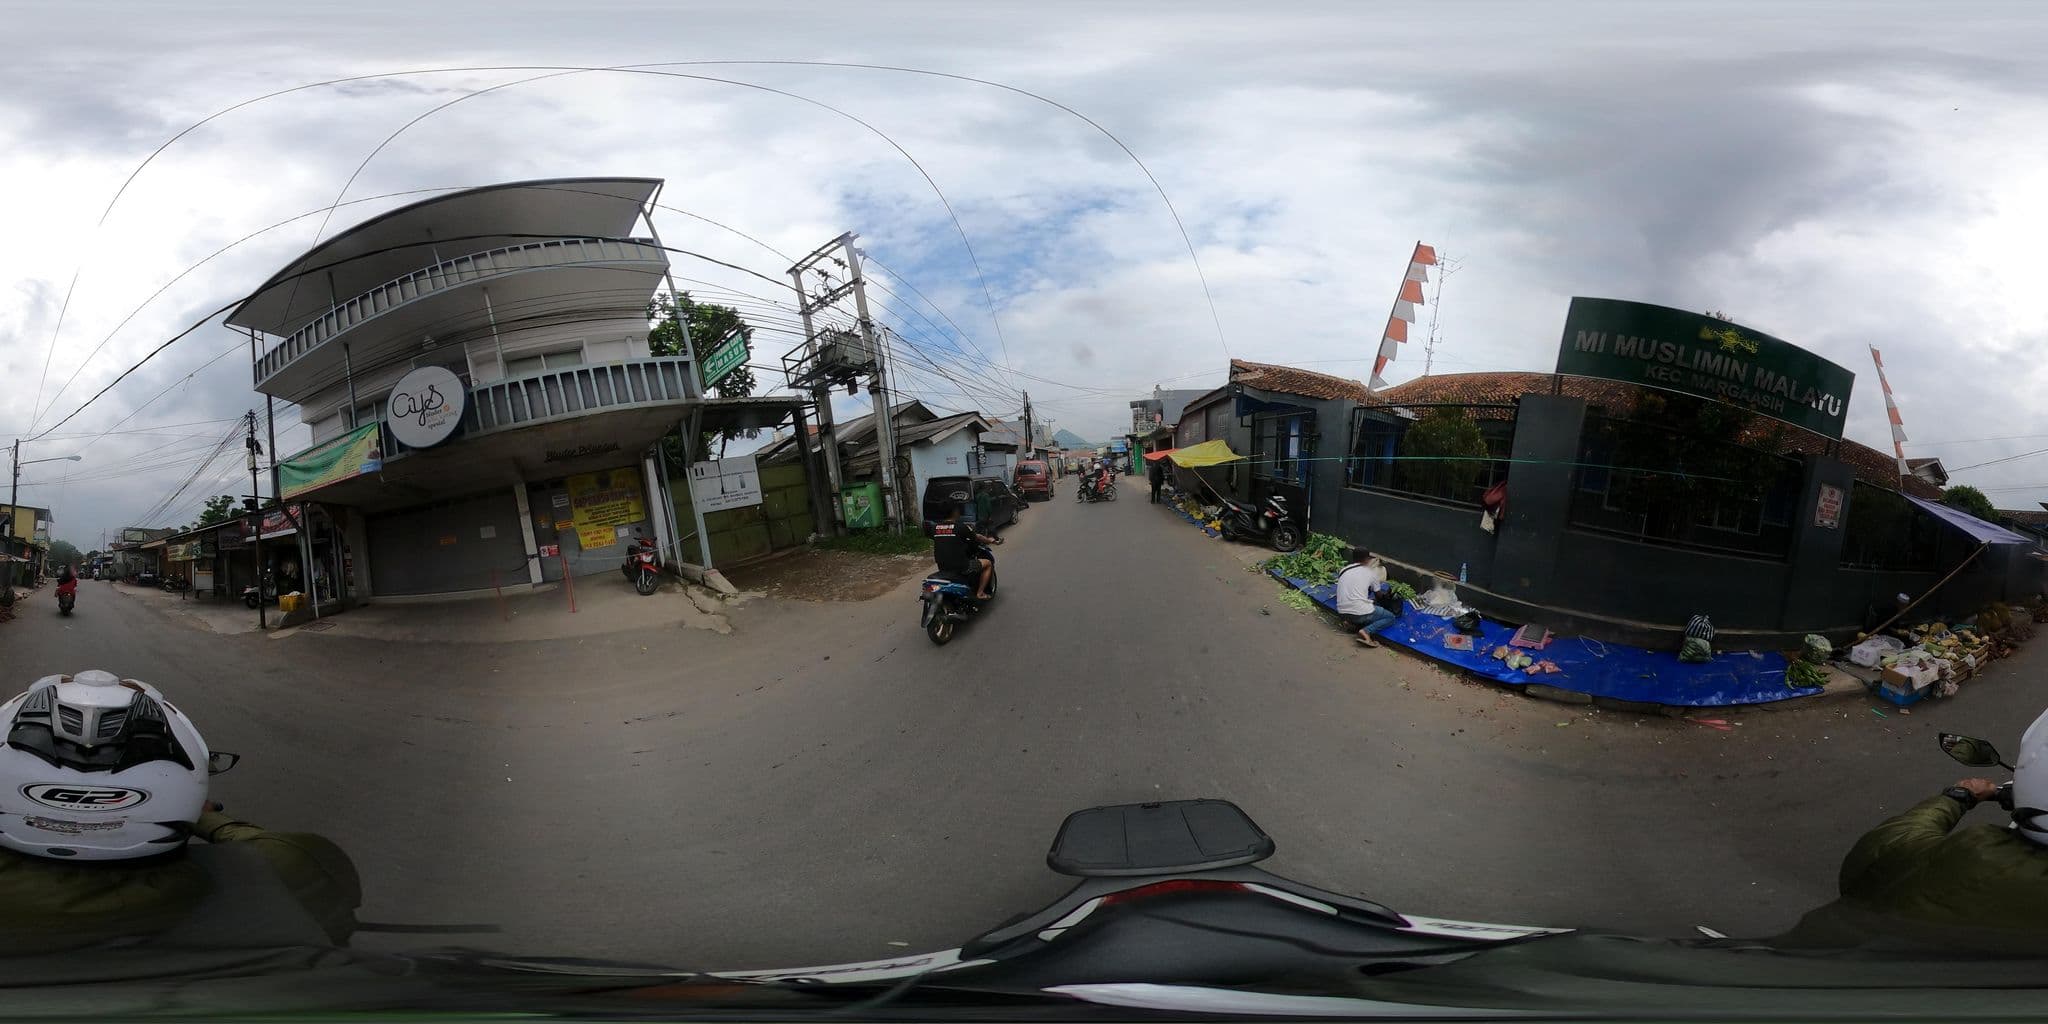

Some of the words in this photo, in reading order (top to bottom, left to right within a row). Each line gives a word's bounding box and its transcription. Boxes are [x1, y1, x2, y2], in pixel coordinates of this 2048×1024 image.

[716, 341, 746, 369] MASUK
[1575, 330, 1607, 353] MI
[1614, 335, 1748, 382] MUSLIMIN
[1754, 367, 1842, 417] MALAYU
[1688, 371, 1785, 414] MARGAASIH
[41, 788, 132, 805] G2
